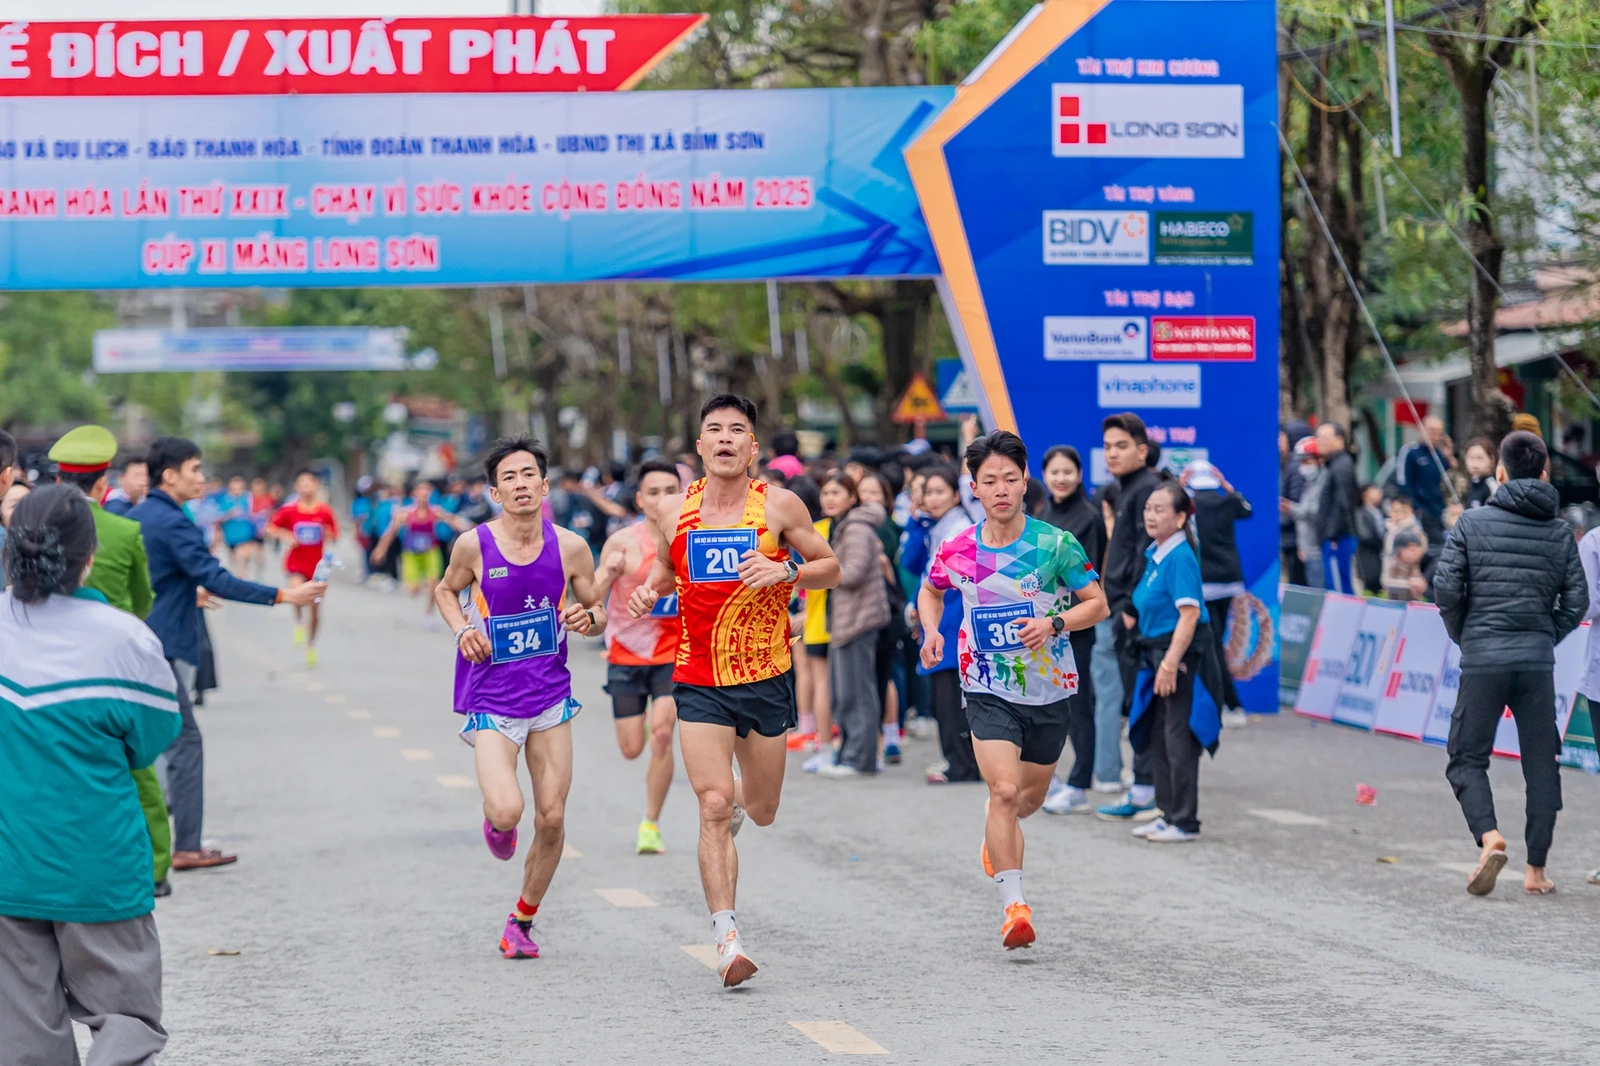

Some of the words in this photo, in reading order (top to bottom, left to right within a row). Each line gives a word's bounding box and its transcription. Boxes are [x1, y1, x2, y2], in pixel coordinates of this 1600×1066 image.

[48, 23, 203, 78] ĐÍCH
[263, 16, 432, 77] XUẤT
[449, 20, 616, 75] PHÁT
[1110, 122, 1180, 138] LONG
[54, 139, 79, 159] DU
[195, 138, 256, 157] THANH
[430, 136, 492, 155] THANH
[557, 134, 609, 153] UBND
[229, 185, 288, 216] XXIX
[312, 186, 374, 222] CHẠY
[691, 174, 746, 209] NĂM
[754, 178, 811, 209] 2025
[1049, 218, 1119, 245] BIDV
[1160, 221, 1230, 237] HABECO
[143, 234, 193, 272] CÚP
[200, 239, 227, 272] XI
[313, 237, 380, 271] LONG
[385, 235, 440, 271] SƠN
[1103, 377, 1195, 395] vinaphone
[706, 548, 739, 574] 20
[1020, 581, 1036, 589] HFC
[508, 628, 541, 654] 34
[988, 622, 1021, 647] 36
